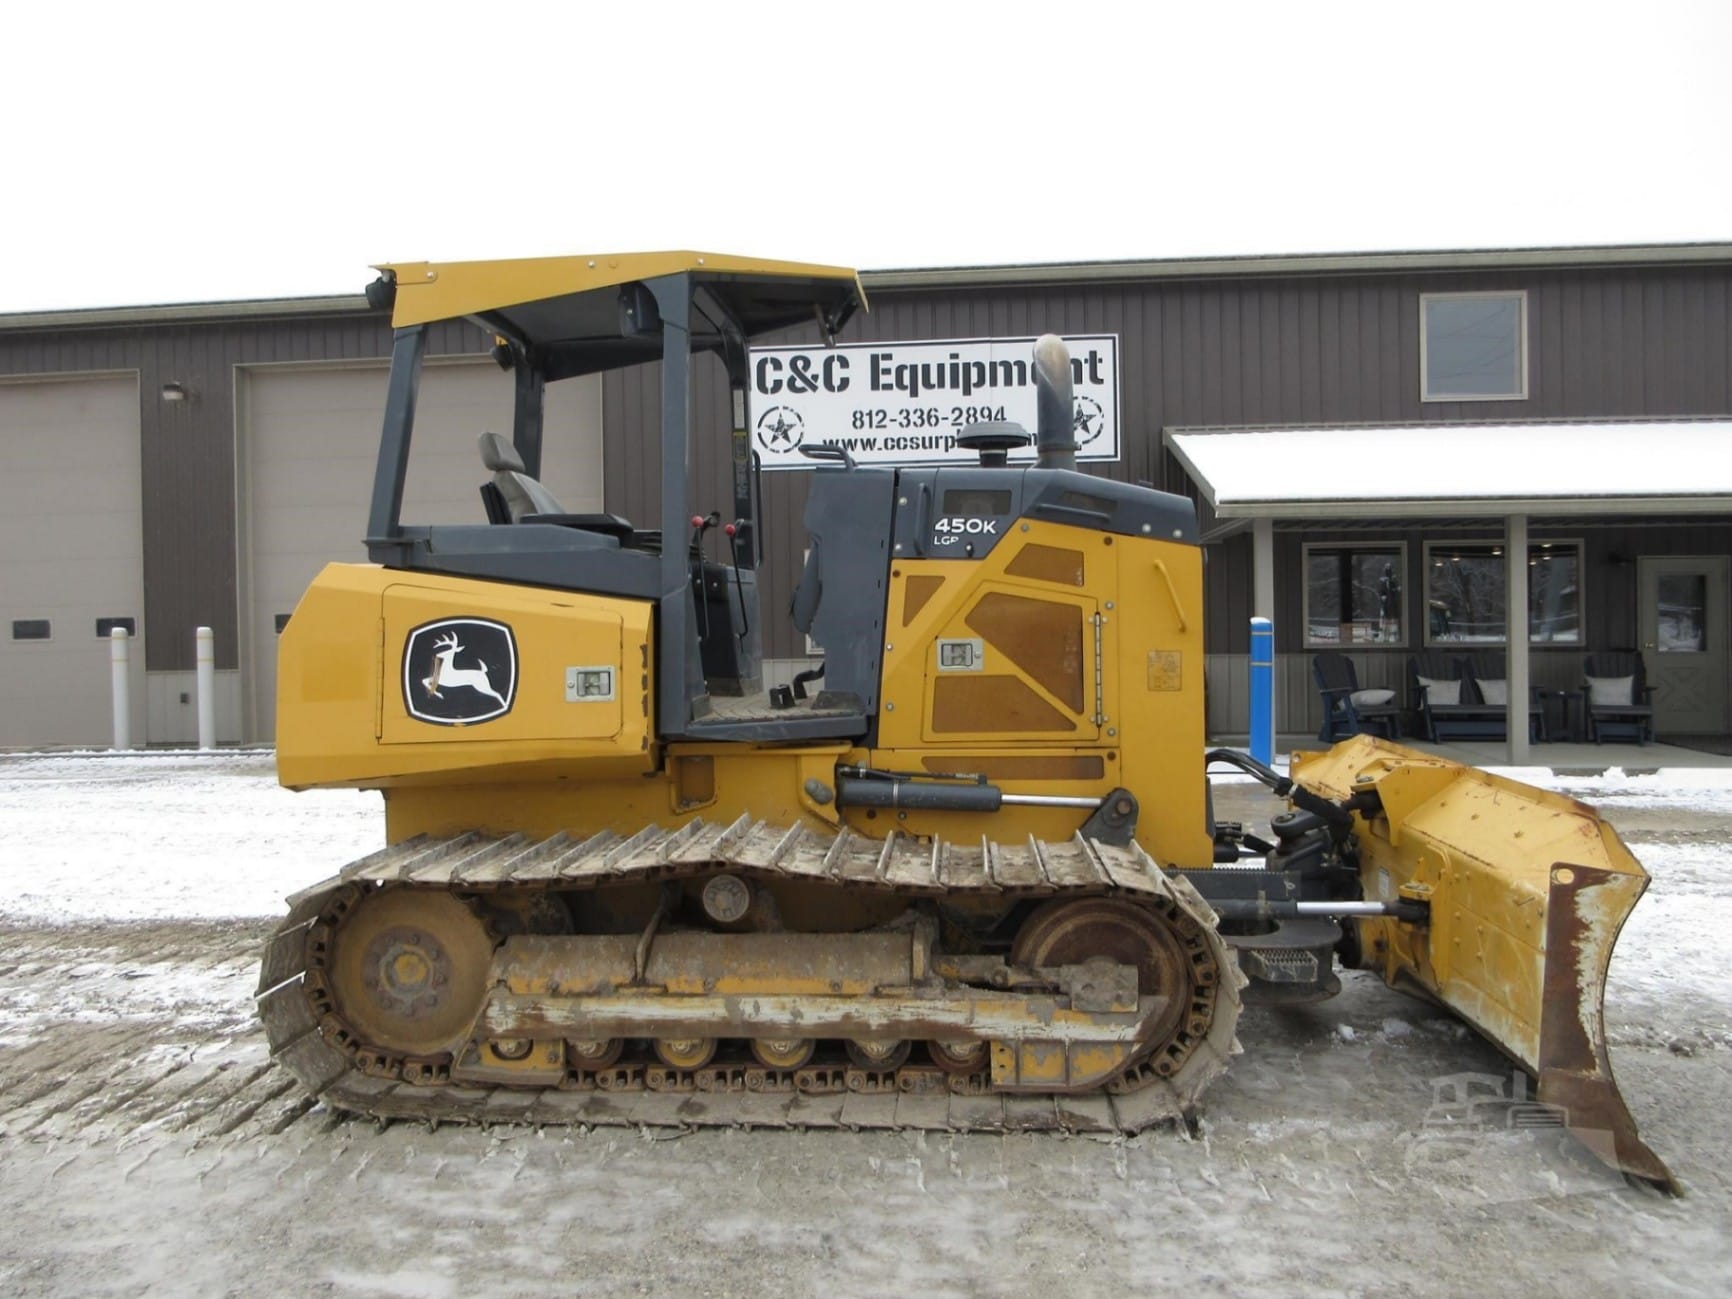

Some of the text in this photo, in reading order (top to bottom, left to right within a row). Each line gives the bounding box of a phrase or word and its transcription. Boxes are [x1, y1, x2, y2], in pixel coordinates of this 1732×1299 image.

[756, 349, 1104, 397] C&C Equipmnt
[852, 406, 1007, 429] 812-336-2894
[934, 518, 997, 534] 450K
[934, 535, 959, 545] LGP
